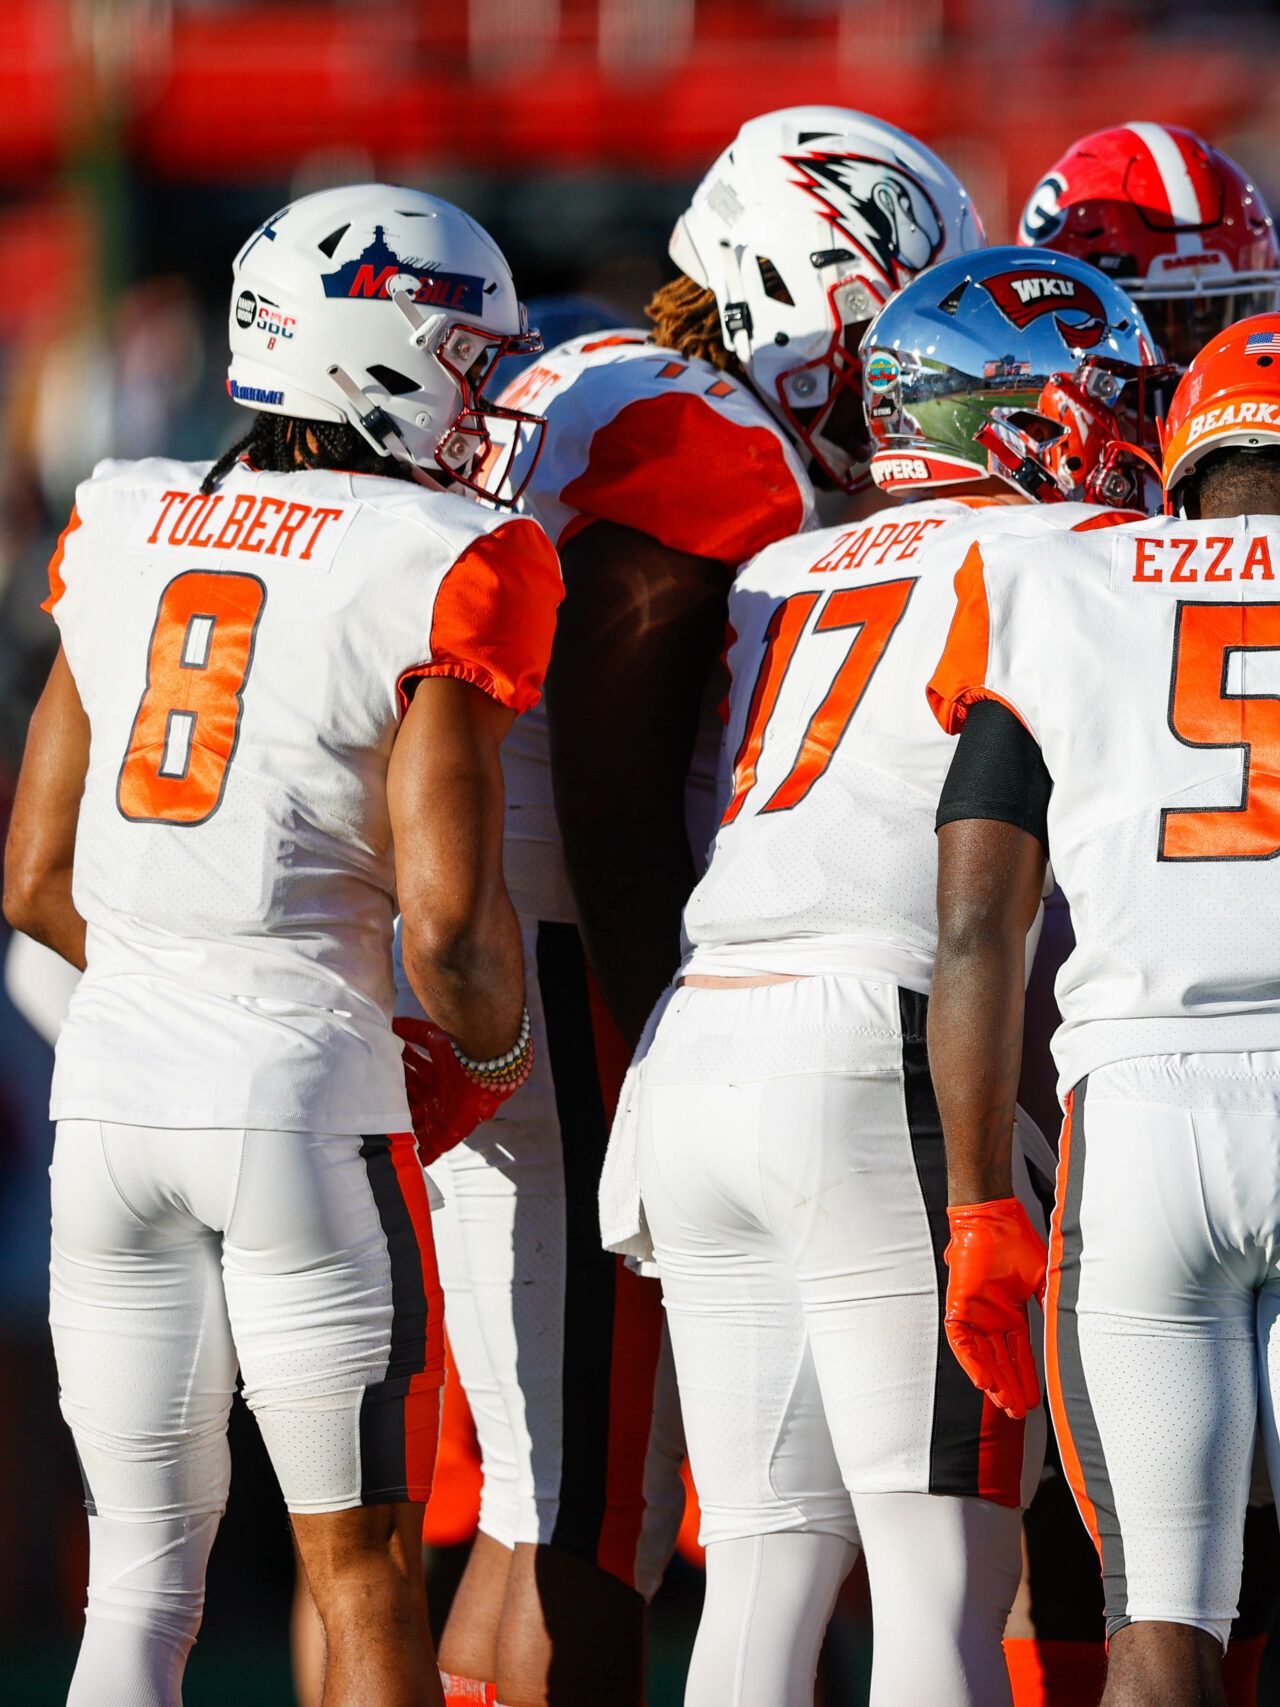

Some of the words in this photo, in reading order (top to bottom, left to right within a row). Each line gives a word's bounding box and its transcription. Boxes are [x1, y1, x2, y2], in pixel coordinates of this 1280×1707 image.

[348, 263, 467, 311] MBILE
[1011, 278, 1075, 304] WKU
[257, 307, 297, 339] SBC
[147, 489, 345, 561] TOLBERT
[808, 518, 947, 574] ZAPPE
[115, 568, 268, 828] 8
[719, 575, 920, 828] 17
